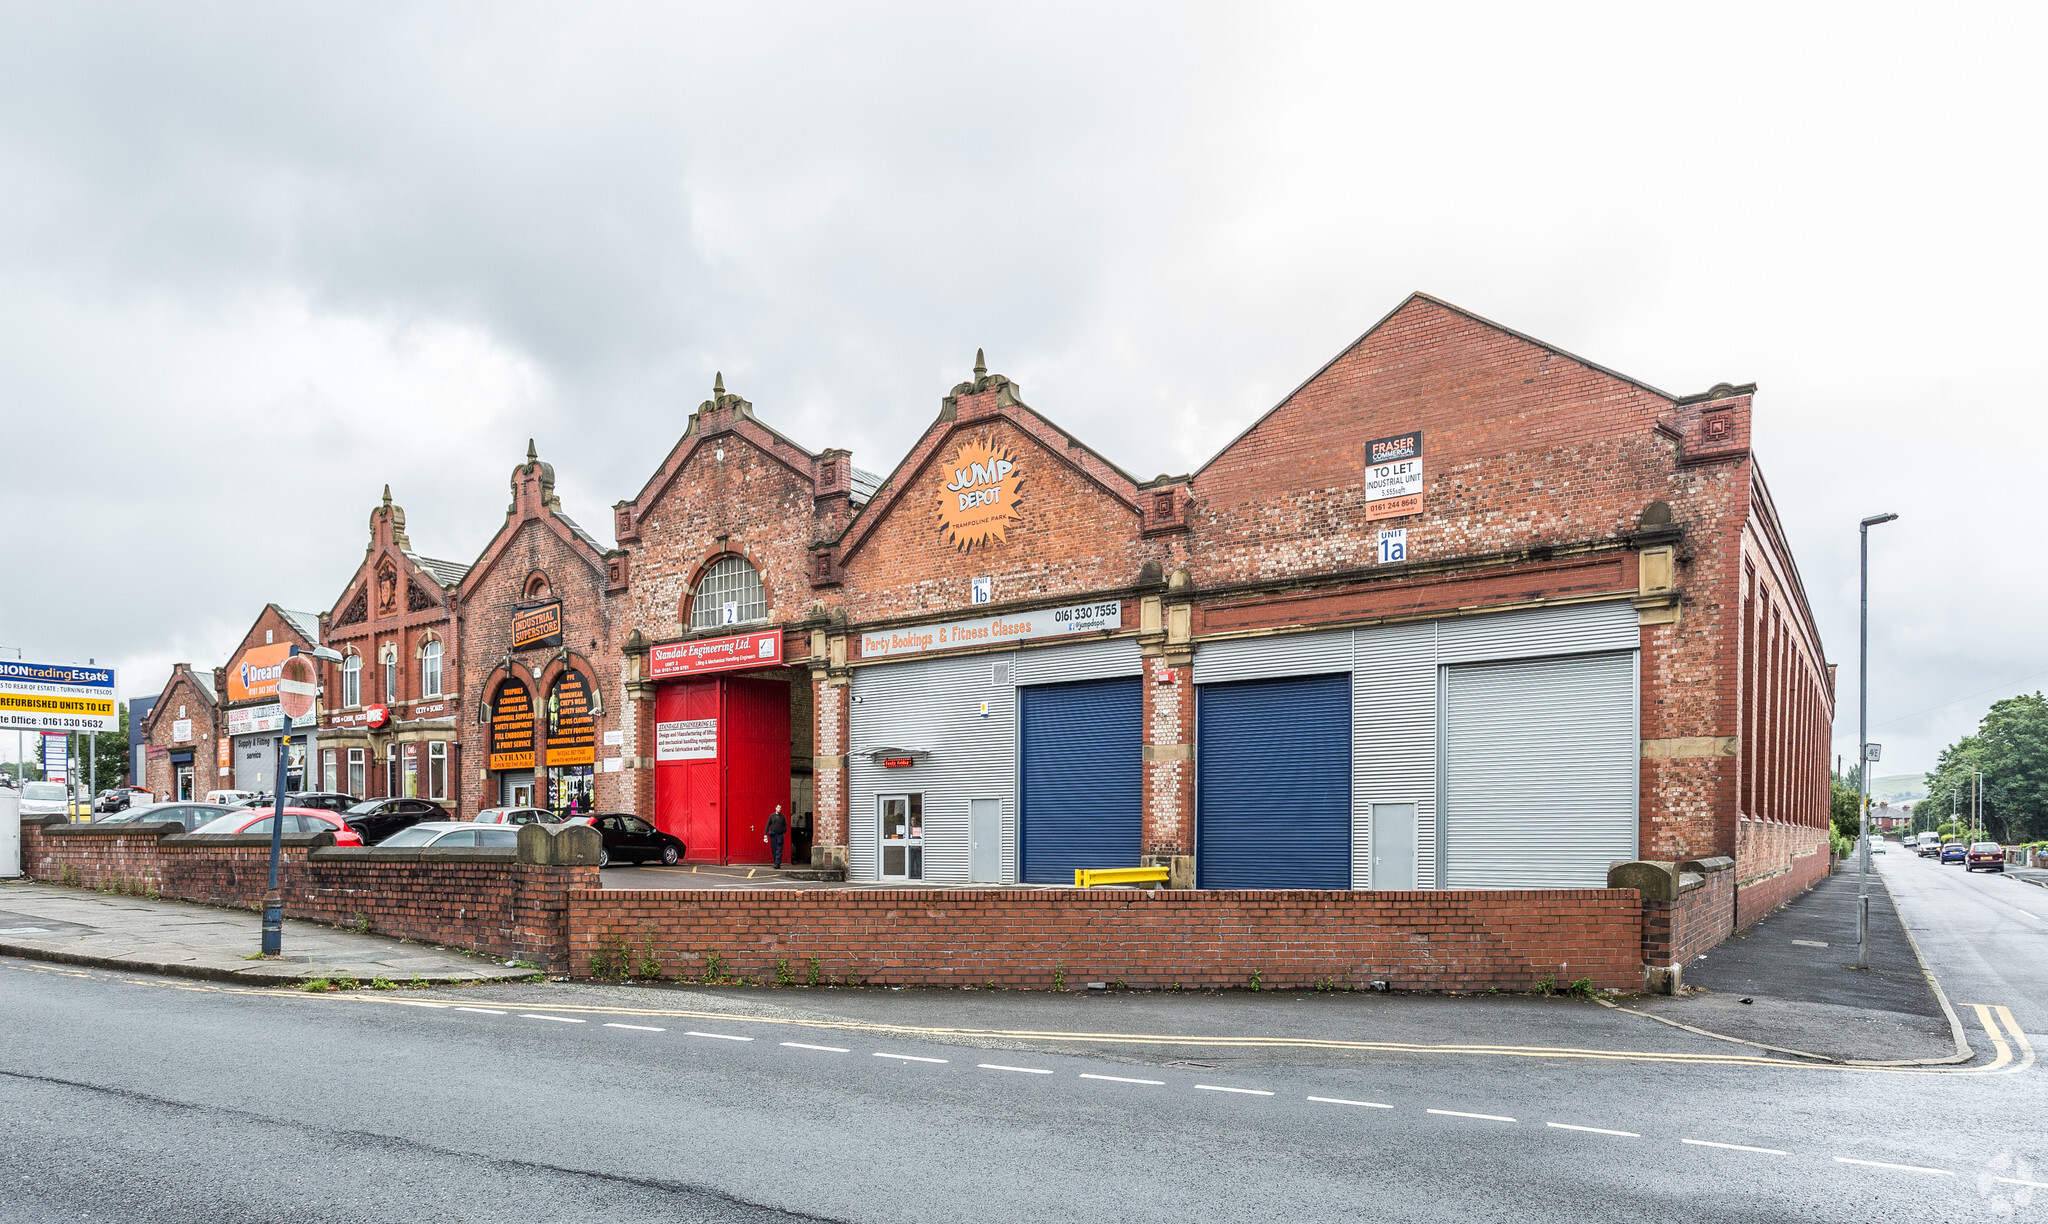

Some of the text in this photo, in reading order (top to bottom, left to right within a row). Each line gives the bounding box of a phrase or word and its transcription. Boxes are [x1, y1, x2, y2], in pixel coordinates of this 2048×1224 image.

[1372, 437, 1414, 454] FRASER
[1372, 447, 1415, 460] COMMERCIAL
[946, 456, 1013, 492] JUMP
[1374, 462, 1413, 479] TO LET
[1367, 473, 1420, 490] INDUSTRIAL UNIT
[958, 485, 1001, 512] DEPOT
[1370, 498, 1418, 512] 0161 244 8640
[952, 519, 989, 528] TRAMPOLINE
[1381, 530, 1402, 539] UNIT
[1380, 539, 1404, 561] 1a
[973, 577, 988, 585] UNIT
[973, 585, 988, 603] 1b
[515, 611, 526, 620] THE
[727, 608, 733, 623] 2
[1055, 603, 1117, 622] 0161 330 7555
[515, 611, 555, 632] INDUSTRIAL
[515, 620, 558, 643] SUPERSTORE
[865, 618, 1032, 654] Party Bookings & Fitness Classes
[655, 637, 751, 661] Standale Engineering Ltd.
[0, 697, 111, 712] REFURBISHED UNITS TO LET
[498, 706, 518, 714] FOOTBALL
[11, 716, 37, 725] Office
[42, 717, 63, 727] 0161
[63, 718, 80, 727] 330
[81, 719, 104, 729] 5632
[515, 712, 535, 721] SUPPLIES
[573, 716, 593, 724] CLOTHING
[494, 720, 533, 731] SAFETY EQUIPMENT
[558, 728, 573, 736] SAFETY
[494, 730, 533, 741] FULL EMBROIDERY
[237, 739, 252, 749] Supply
[256, 737, 270, 747] Fitting
[500, 740, 514, 749] PRINT
[513, 739, 532, 748] SERVICE
[246, 751, 262, 760] service
[494, 752, 533, 762] ENTRANCE
